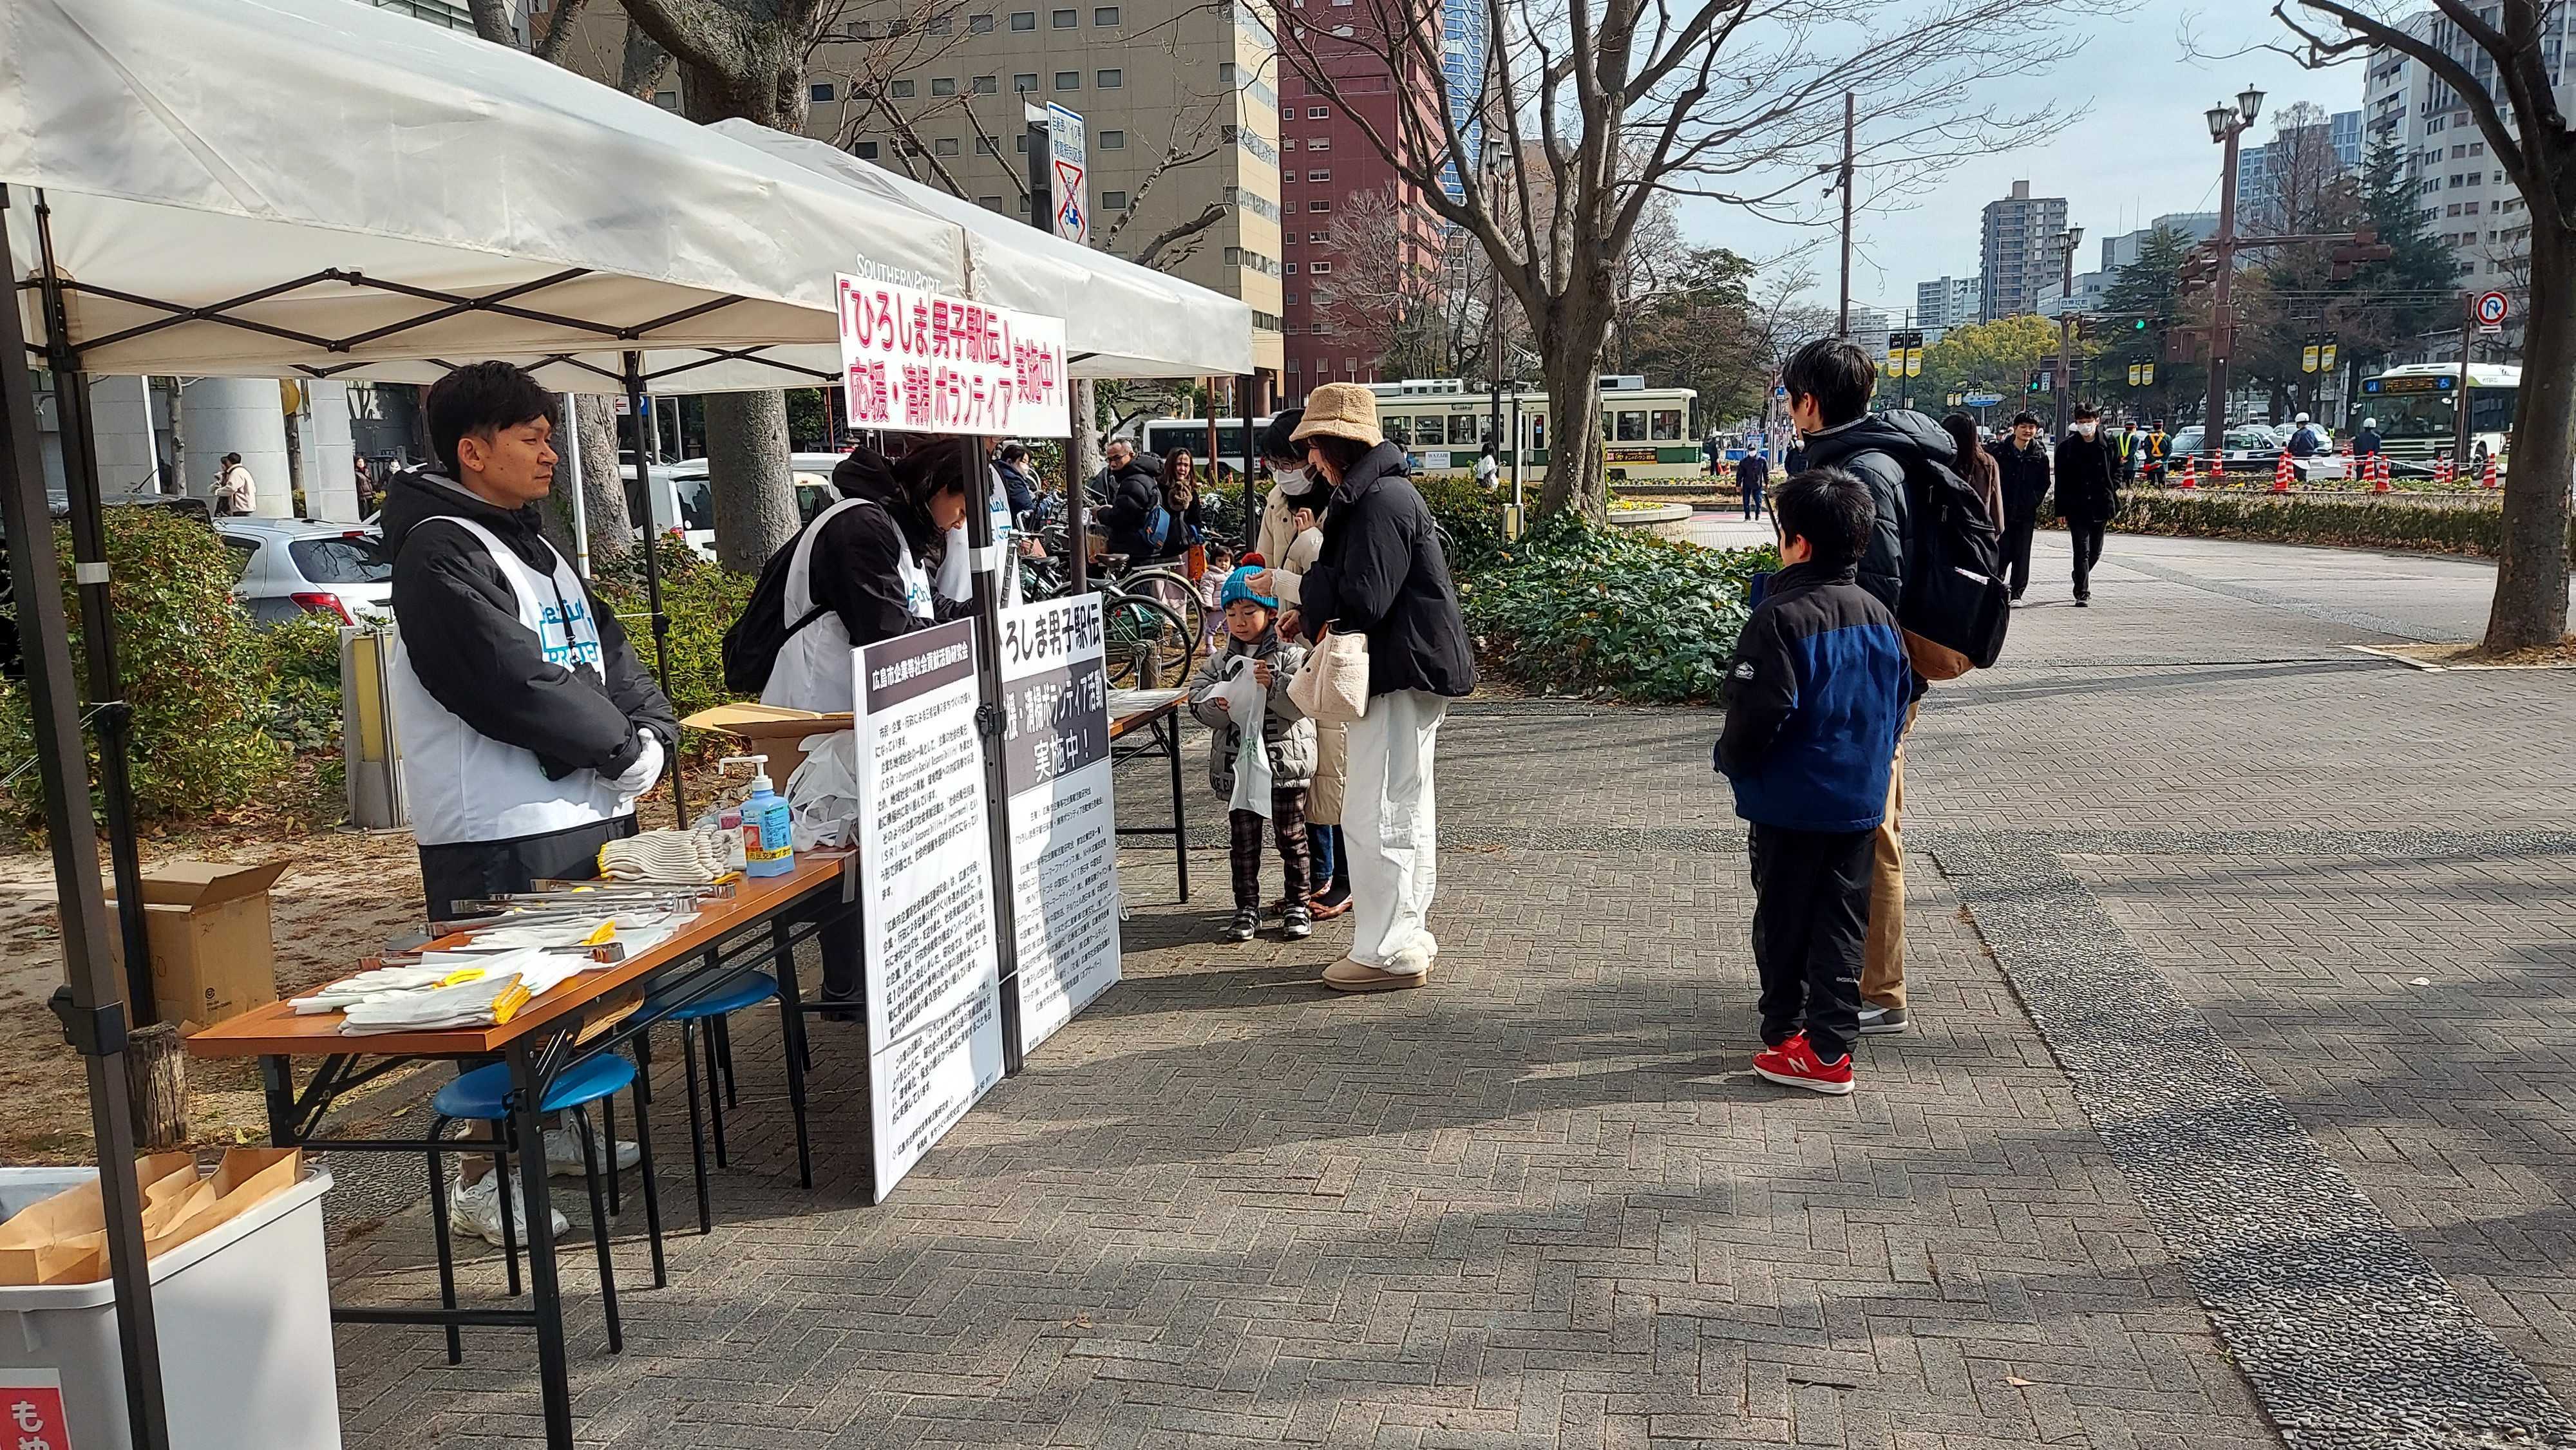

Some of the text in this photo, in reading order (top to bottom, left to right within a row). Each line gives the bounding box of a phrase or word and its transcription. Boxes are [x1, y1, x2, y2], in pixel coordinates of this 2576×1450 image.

[848, 357, 1013, 429] 応援・清掃ボランティア
[998, 604, 1101, 664] ろしま男子駅伝
[872, 640, 969, 692] 広島市企業等社会貢献活動研究会
[1002, 668, 1104, 743] 援・清掃ボランティア活動
[1034, 727, 1090, 784] 実施中！
[1788, 1057, 1811, 1073] N
